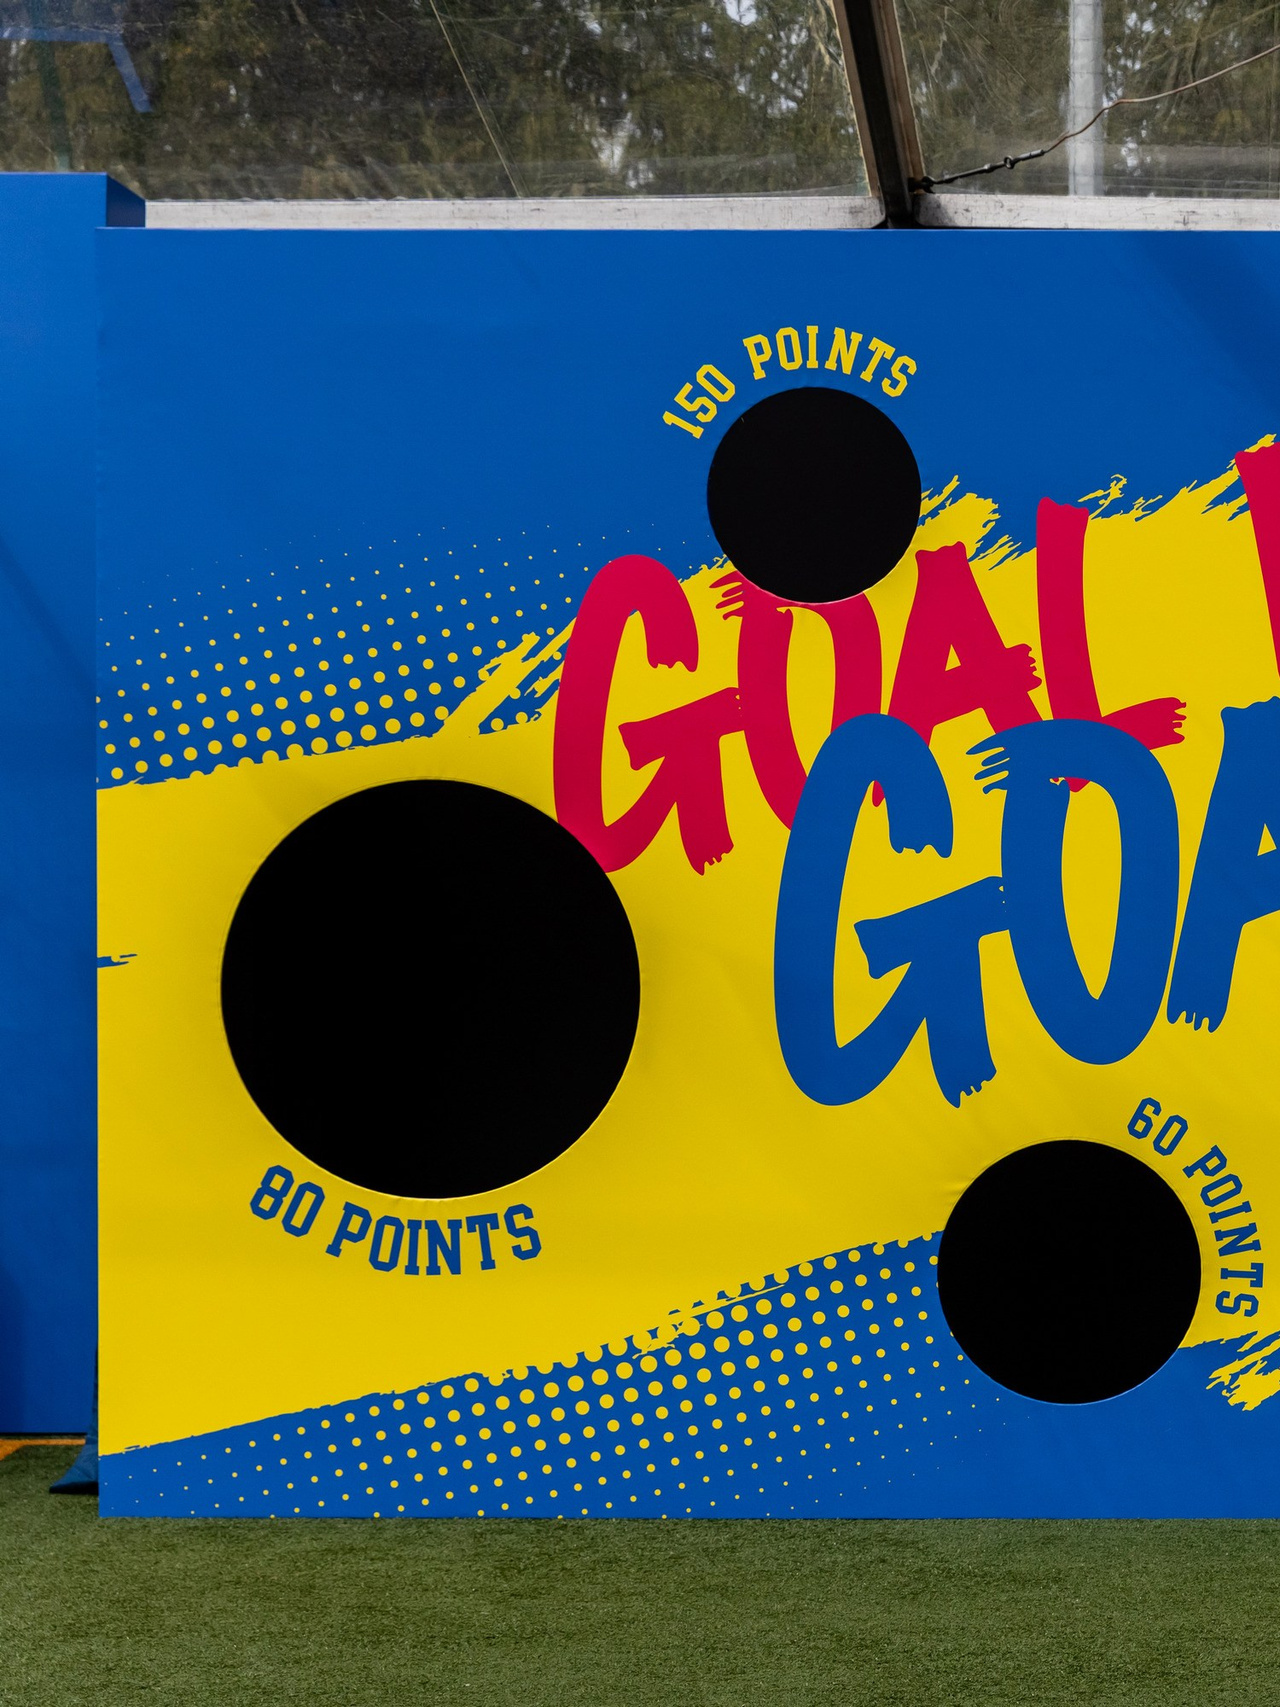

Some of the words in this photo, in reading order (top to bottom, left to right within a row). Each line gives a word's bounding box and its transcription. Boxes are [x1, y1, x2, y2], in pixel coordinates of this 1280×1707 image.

[663, 365, 735, 437] 150
[743, 326, 916, 396] POINTS
[251, 1166, 322, 1236] 80
[327, 1203, 540, 1275] POINTS
[1129, 1098, 1187, 1155] 60
[1184, 1147, 1262, 1316] POINTS
